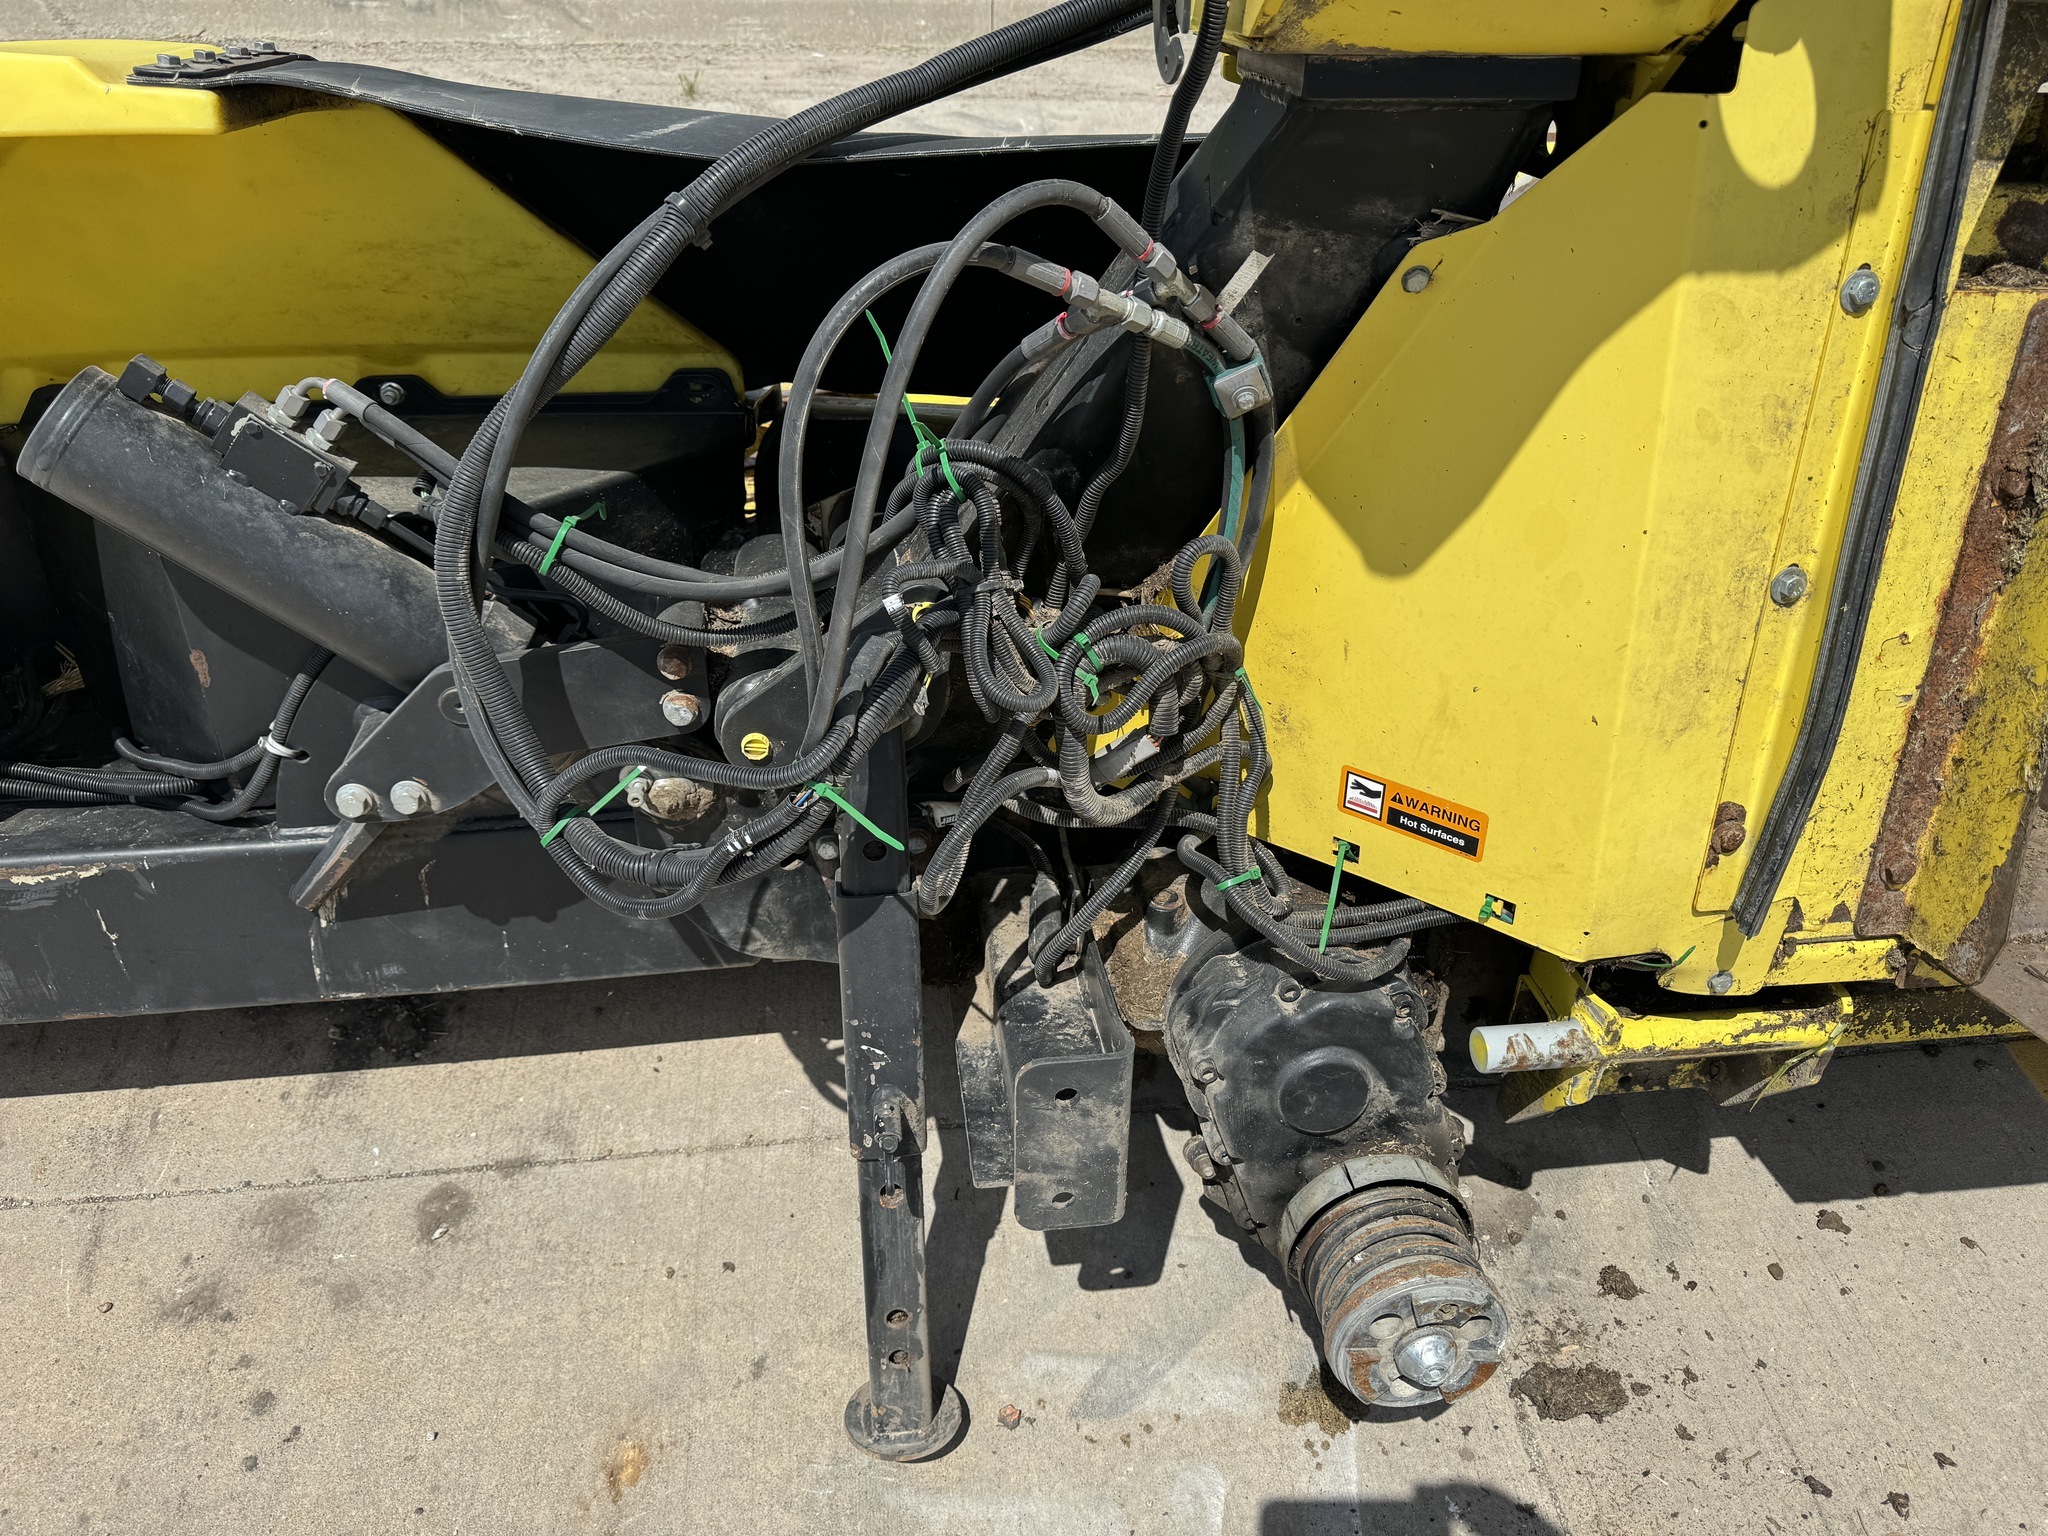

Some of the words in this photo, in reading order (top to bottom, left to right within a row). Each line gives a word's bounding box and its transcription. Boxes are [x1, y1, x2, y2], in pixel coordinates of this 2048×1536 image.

[1399, 815, 1418, 830] Hot
[1419, 823, 1465, 846] Surfaces
[1405, 795, 1481, 832] WARNING
